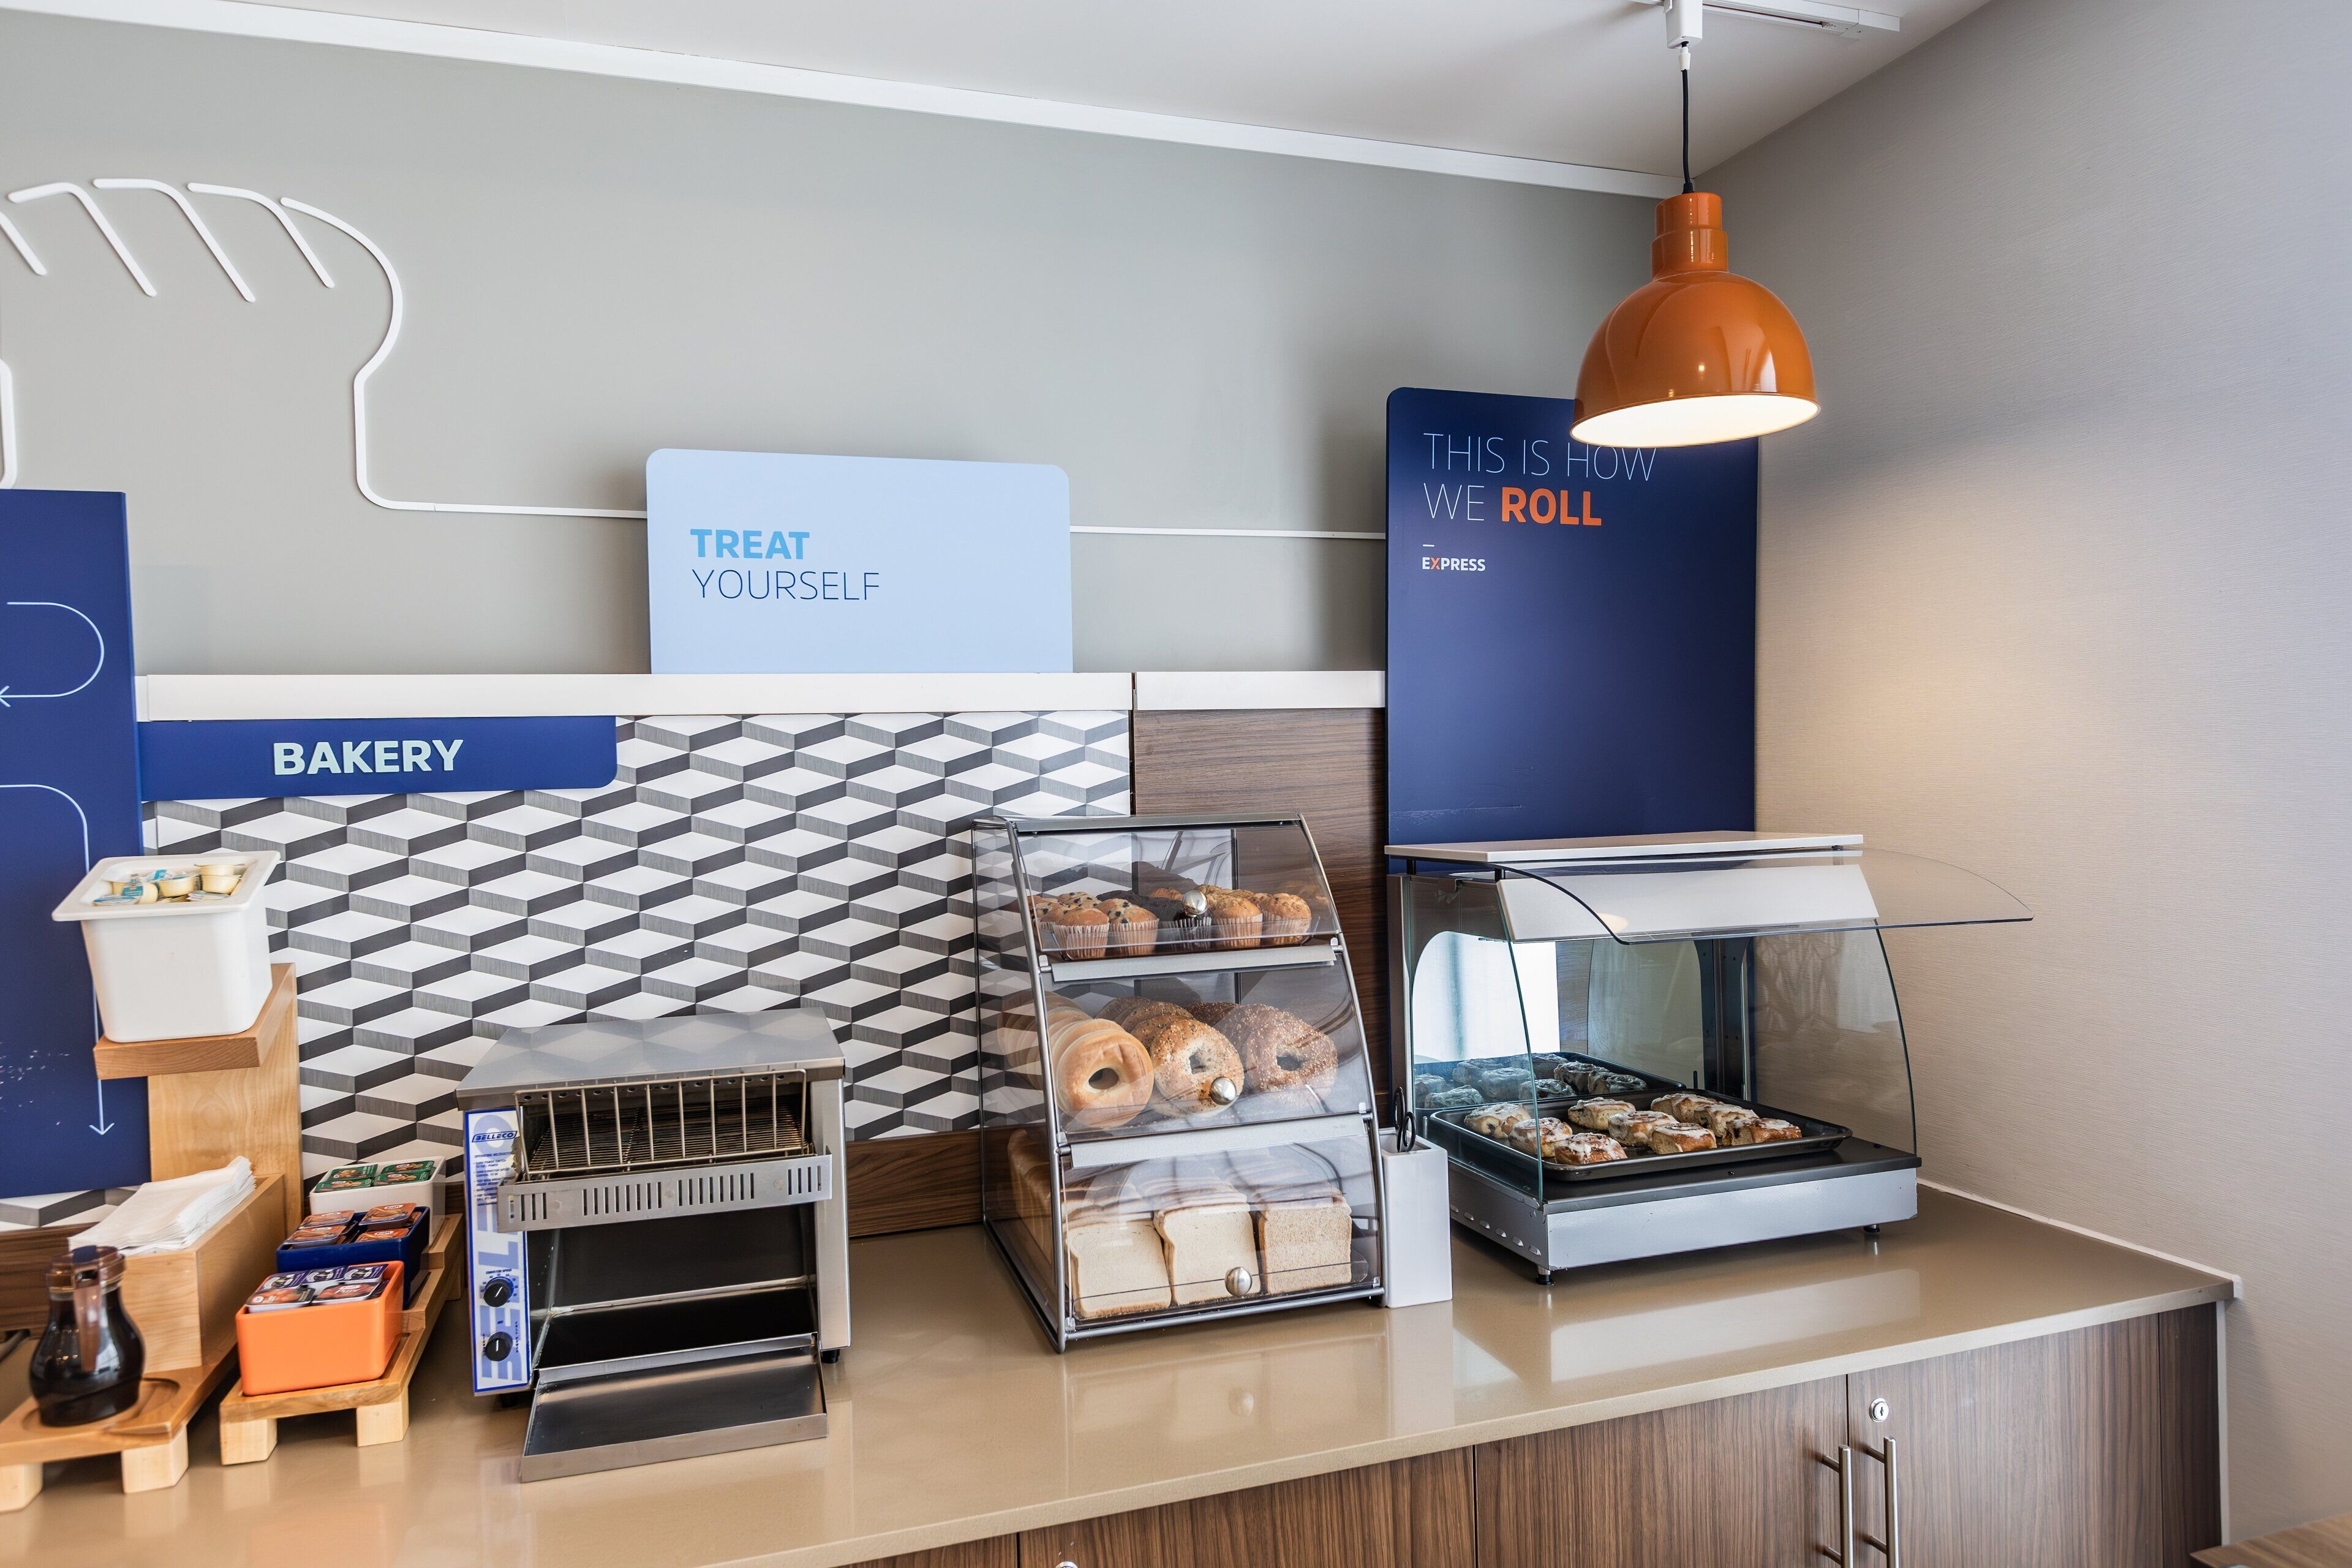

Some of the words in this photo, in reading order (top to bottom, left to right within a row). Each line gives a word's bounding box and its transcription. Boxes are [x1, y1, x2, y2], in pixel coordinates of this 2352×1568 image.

[1422, 432, 1506, 474] THIS
[1523, 439, 1550, 477] IS
[1567, 442, 1657, 481] HOW
[1423, 482, 1485, 522] WE
[1501, 486, 1602, 526] ROLL
[690, 529, 810, 560] TREAT
[1422, 556, 1487, 571] EXPRESS
[692, 569, 880, 601] YOURSELF
[273, 739, 464, 775] BAKERY
